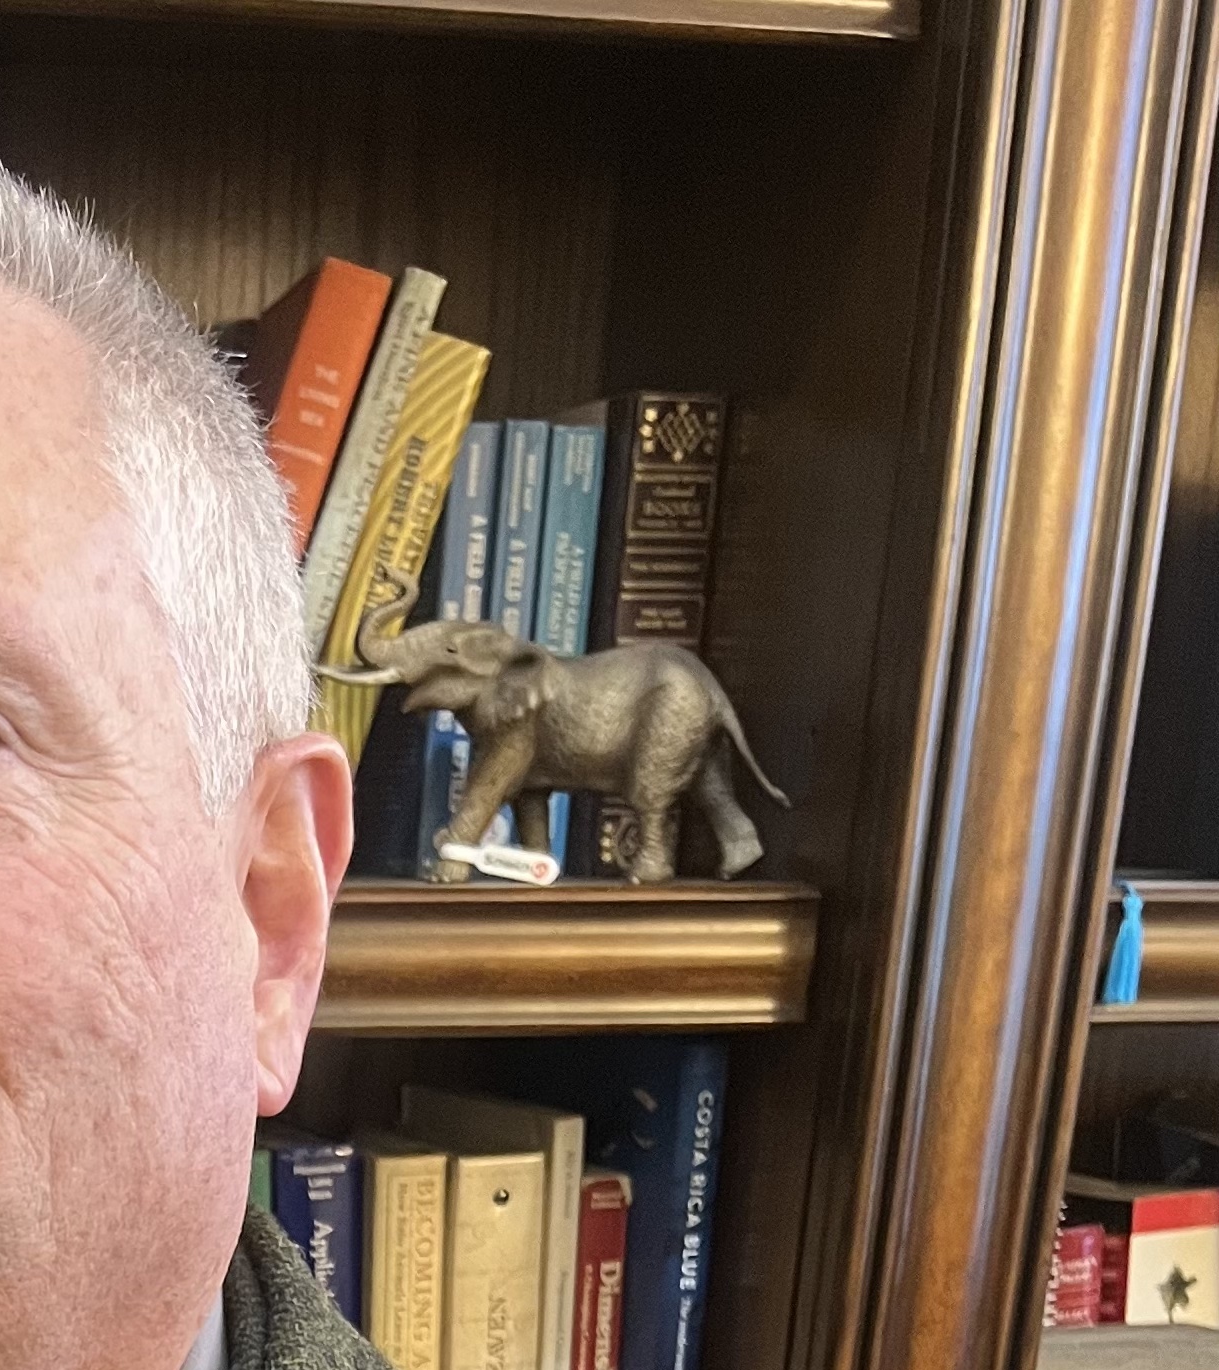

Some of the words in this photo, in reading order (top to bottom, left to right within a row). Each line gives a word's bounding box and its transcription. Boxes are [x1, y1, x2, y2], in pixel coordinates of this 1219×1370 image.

[380, 434, 432, 528] ROBERT
[692, 1089, 714, 1168] COSTA
[687, 1171, 708, 1230] RICA
[412, 1178, 436, 1342] BECOMING
[681, 1233, 702, 1293] BLUE
